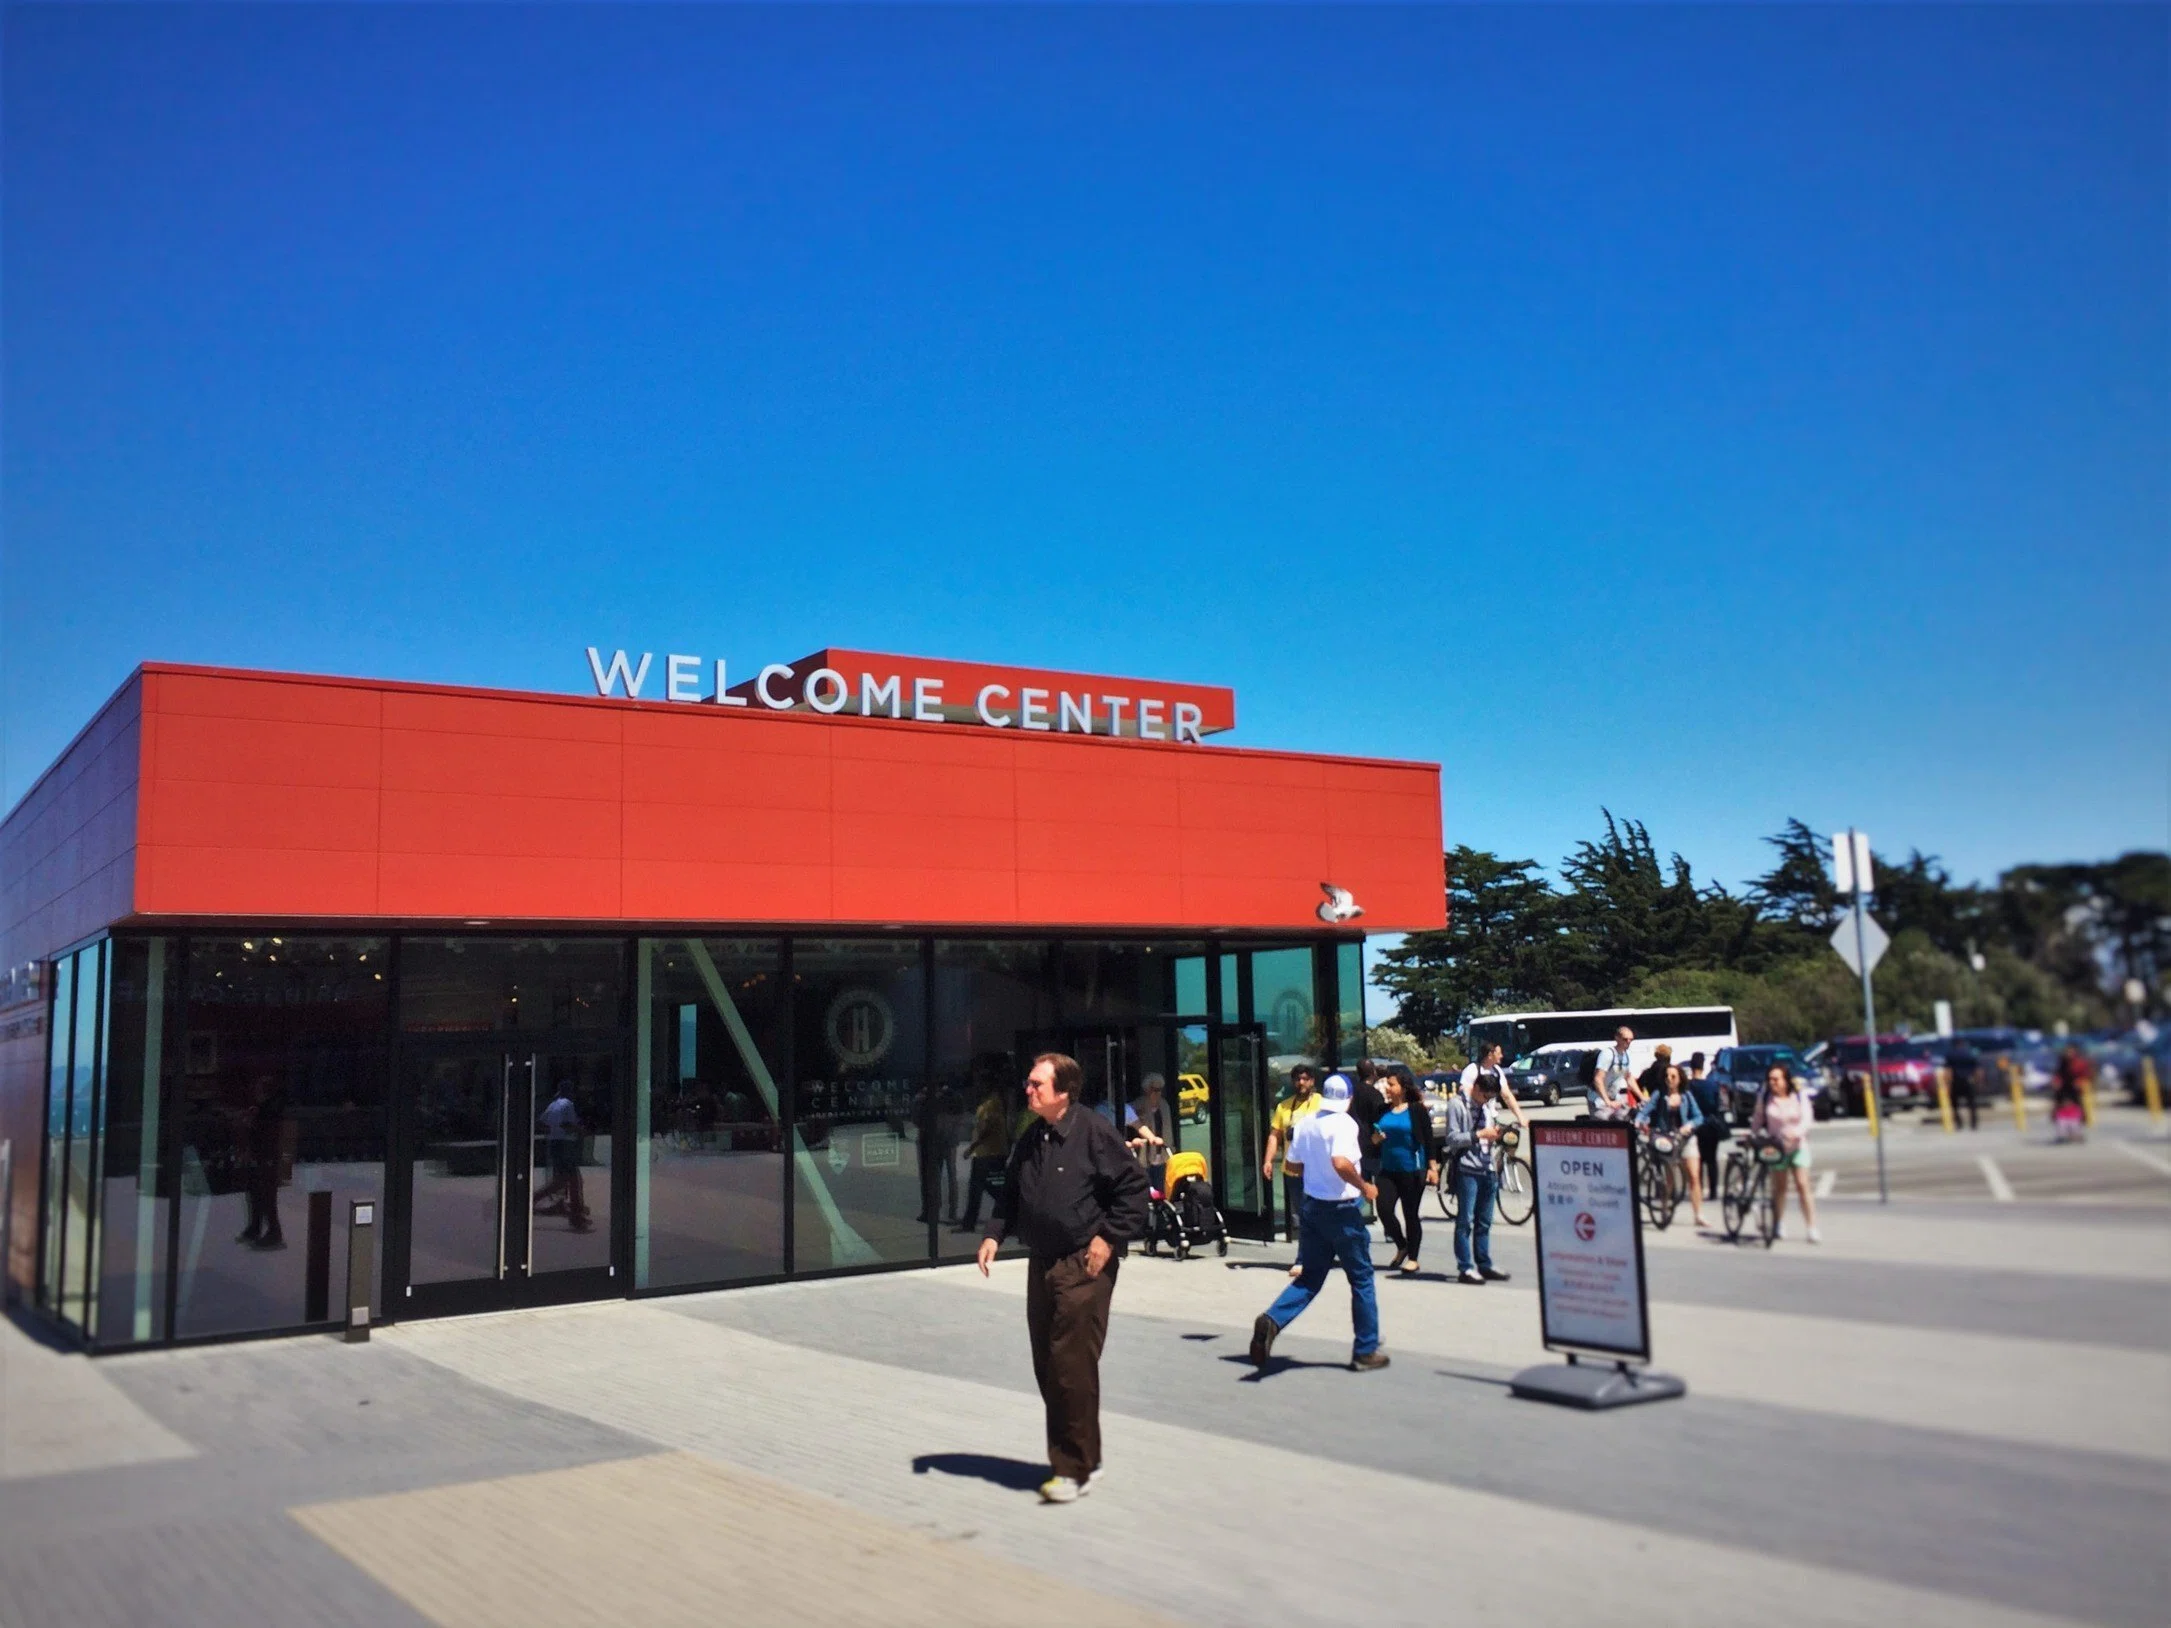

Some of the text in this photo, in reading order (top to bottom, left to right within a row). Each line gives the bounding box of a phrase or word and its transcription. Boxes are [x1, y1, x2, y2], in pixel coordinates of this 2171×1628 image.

[586, 646, 1204, 744] WELCOME CENTER
[811, 1078, 910, 1093] WELCOME
[811, 1093, 910, 1109] CENTER
[1545, 1130, 1618, 1146] WELCOME CENTER
[1560, 1159, 1604, 1177] OPEN
